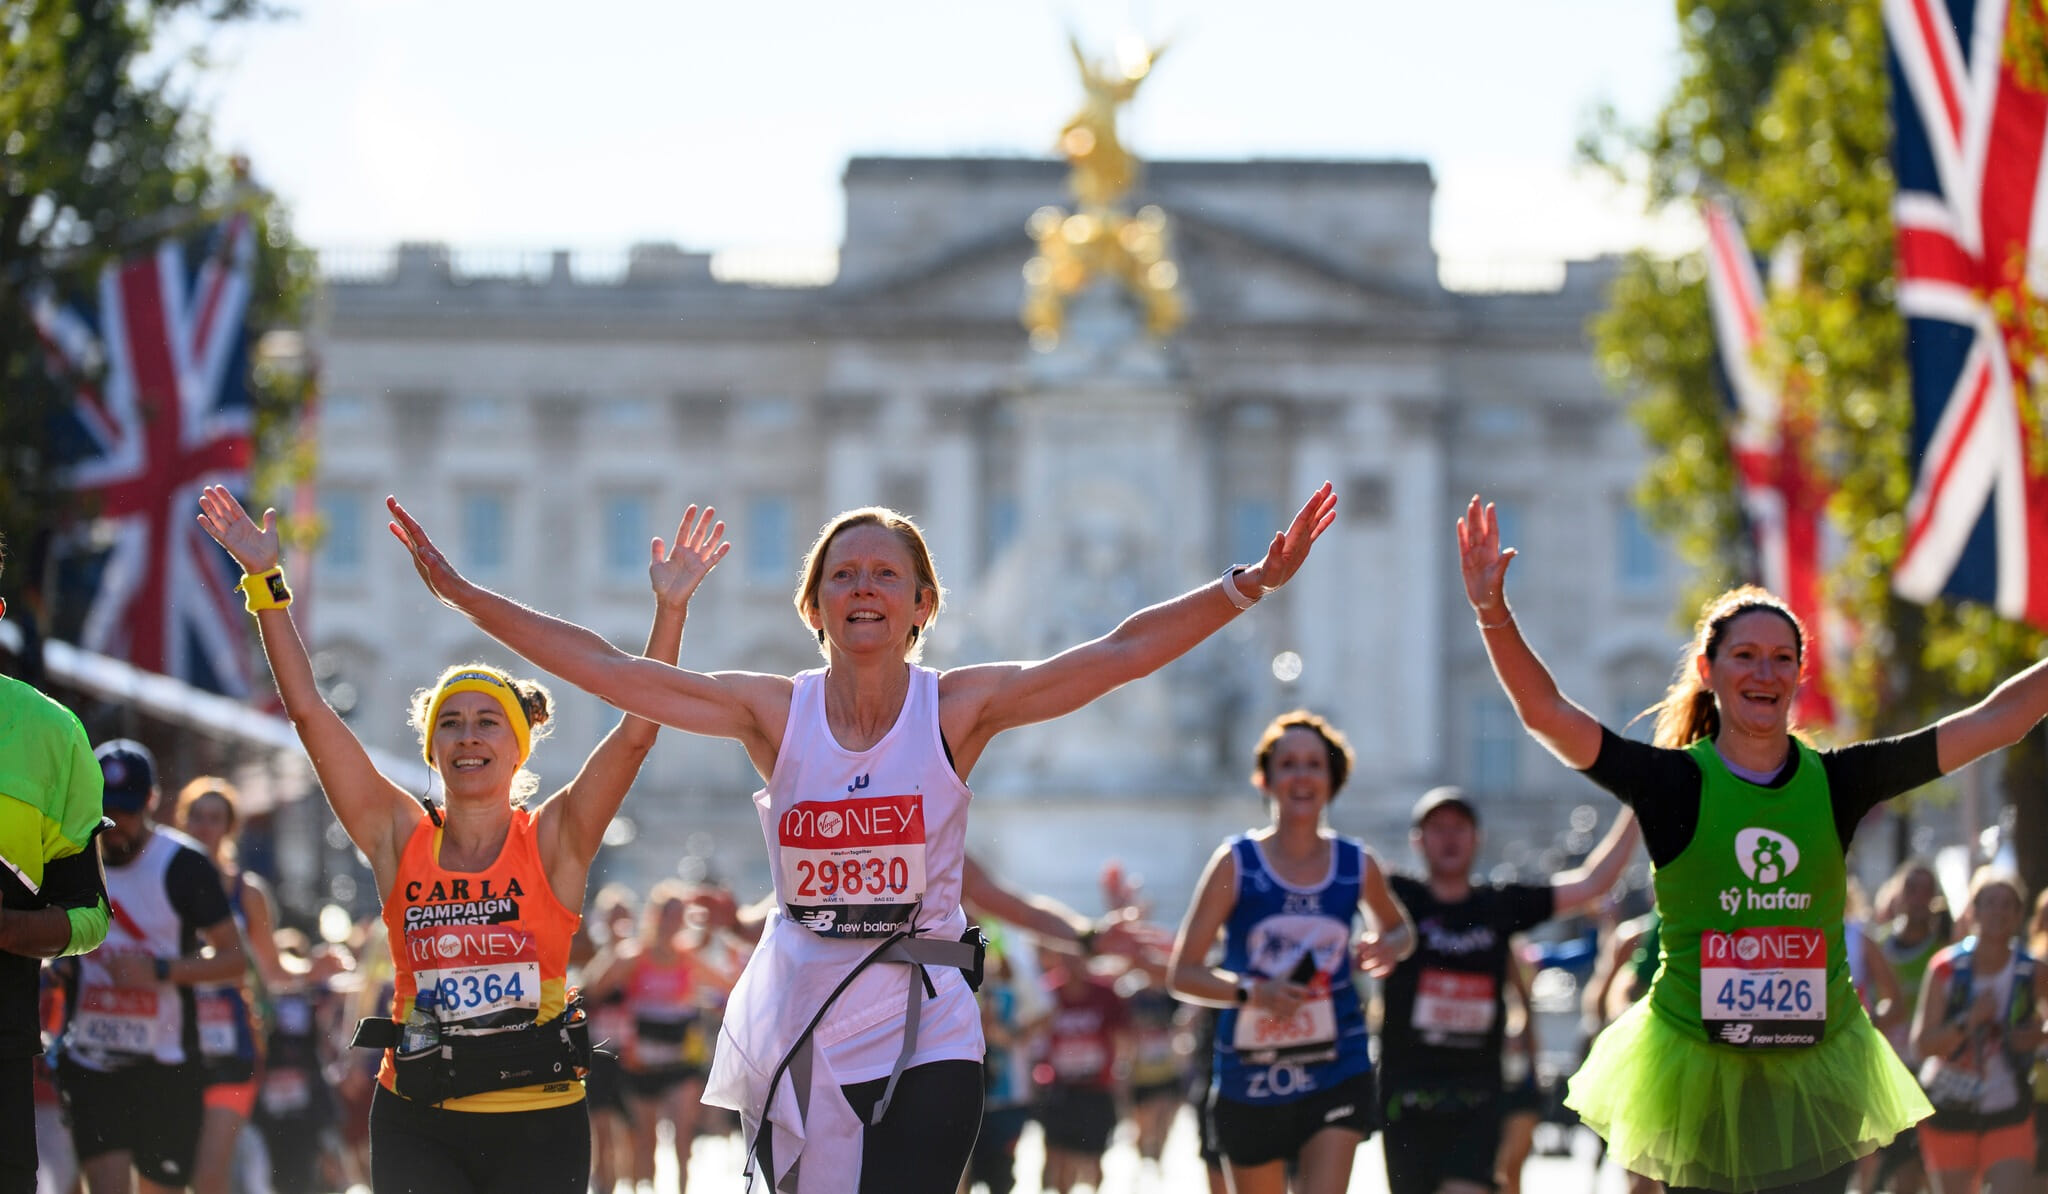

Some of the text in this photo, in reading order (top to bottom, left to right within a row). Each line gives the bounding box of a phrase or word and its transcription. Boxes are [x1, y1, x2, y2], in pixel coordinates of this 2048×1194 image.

[785, 804, 915, 838] MONEY
[818, 813, 841, 834] Virgin
[405, 877, 525, 902] CARLA
[797, 856, 908, 897] 29830
[405, 899, 512, 922] CAMPAIGN
[1718, 887, 1811, 916] tŷ hafan
[837, 921, 904, 933] new balanc
[411, 933, 527, 962] MONEY
[1708, 934, 1820, 960] MONEY
[1716, 978, 1812, 1012] 45426
[1753, 1033, 1815, 1044] new balance
